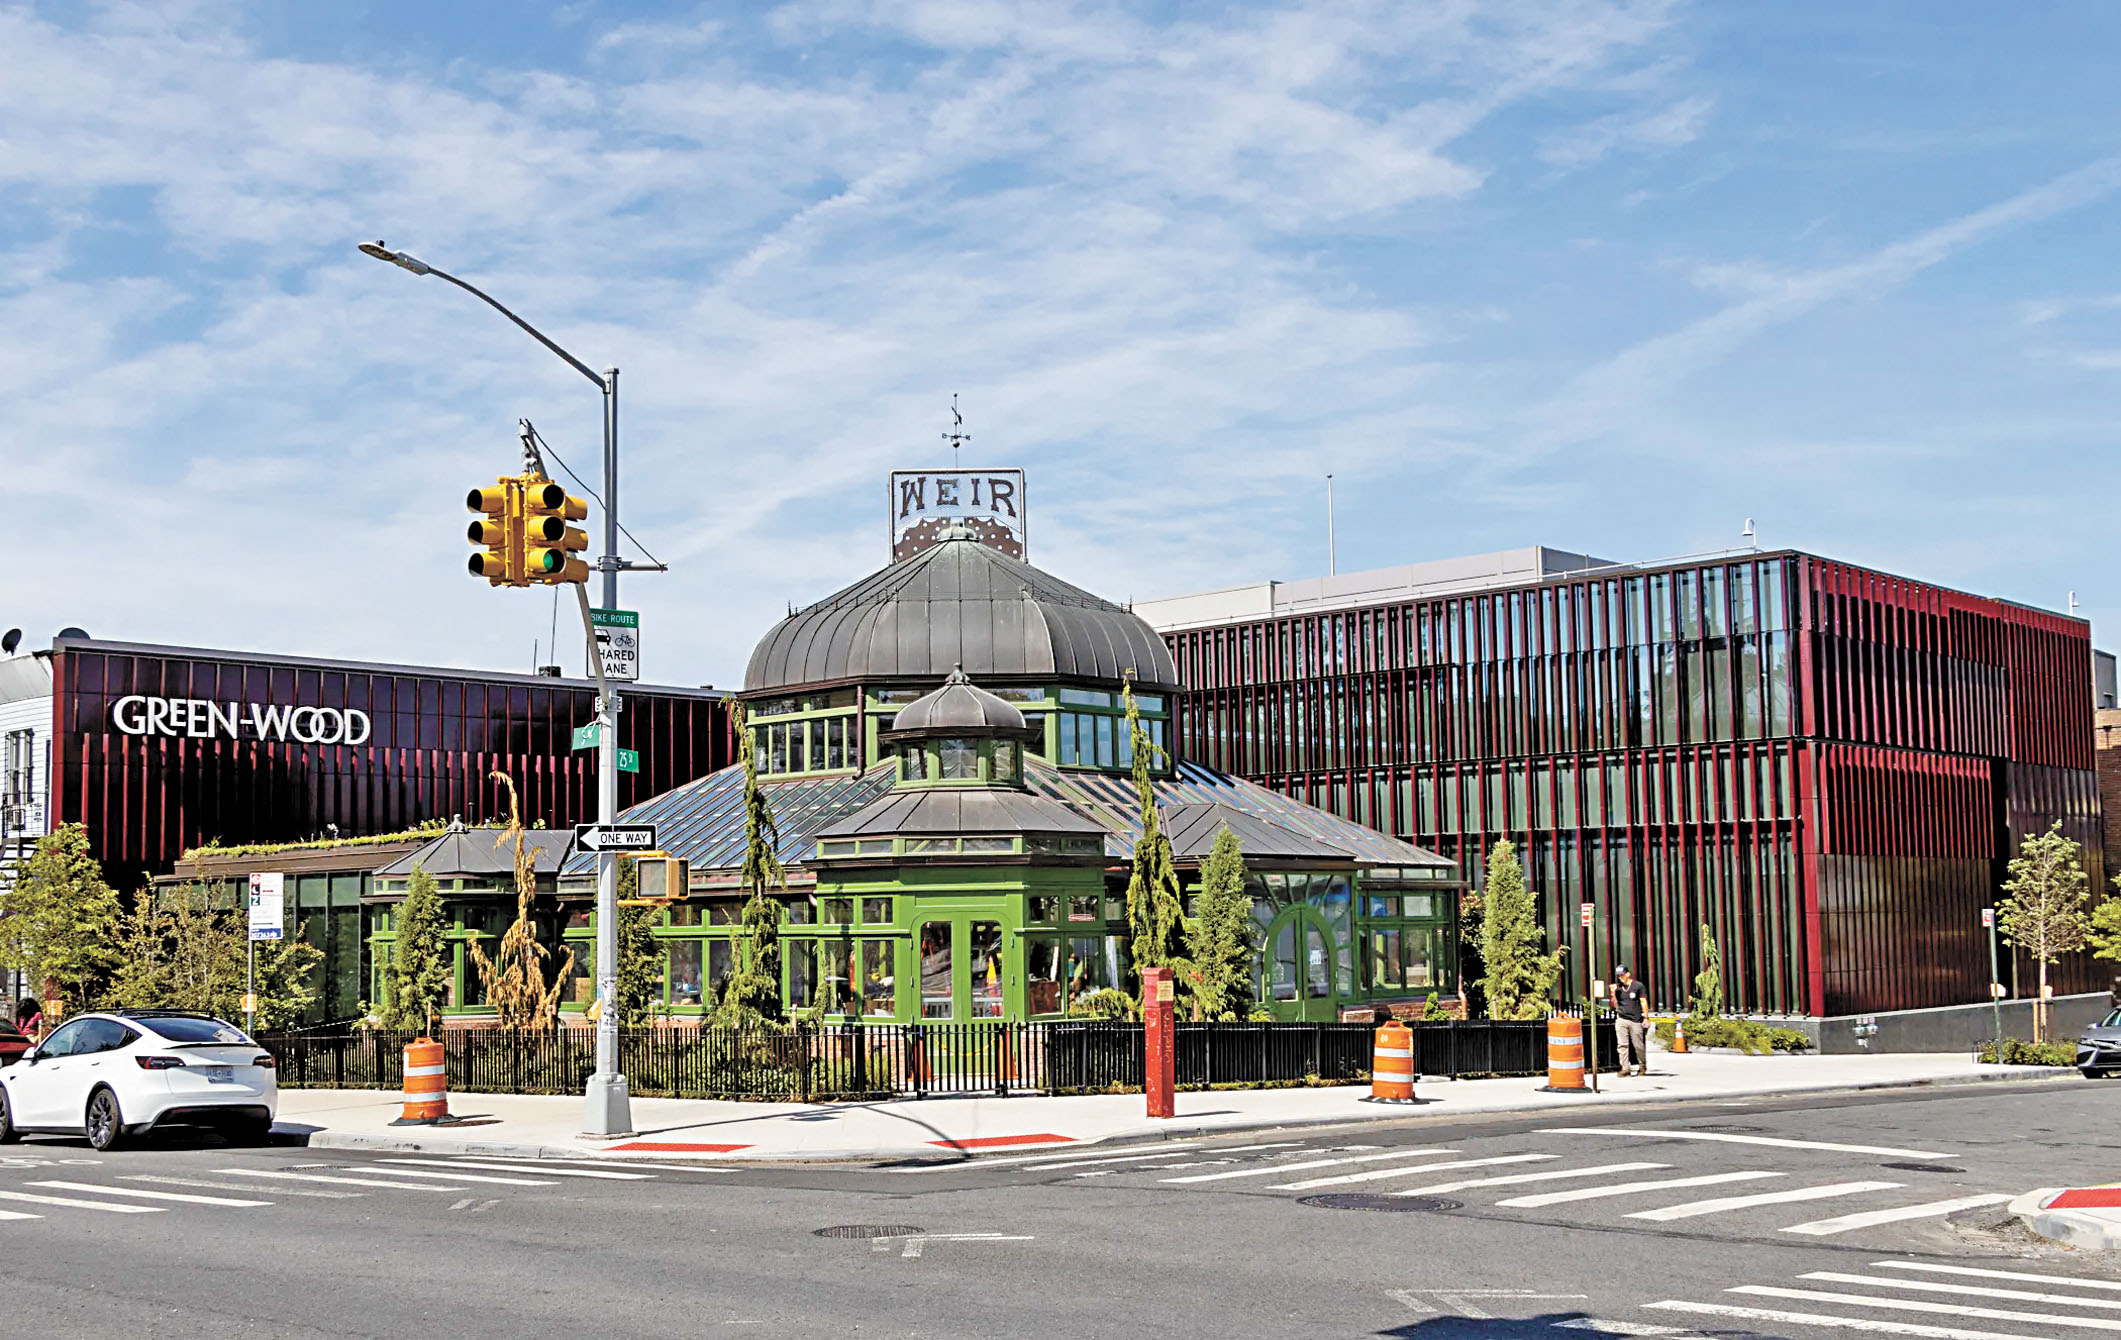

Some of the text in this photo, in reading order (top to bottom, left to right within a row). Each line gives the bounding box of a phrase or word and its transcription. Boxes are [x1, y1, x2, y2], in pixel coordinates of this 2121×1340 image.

[900, 476, 1016, 519] WEIR
[591, 613, 635, 624] BIKE ROUTE
[599, 649, 635, 661] HARED
[605, 663, 627, 674] ANE
[113, 695, 371, 745] GREEN-WOOD
[600, 833, 648, 843] ONE WAY
